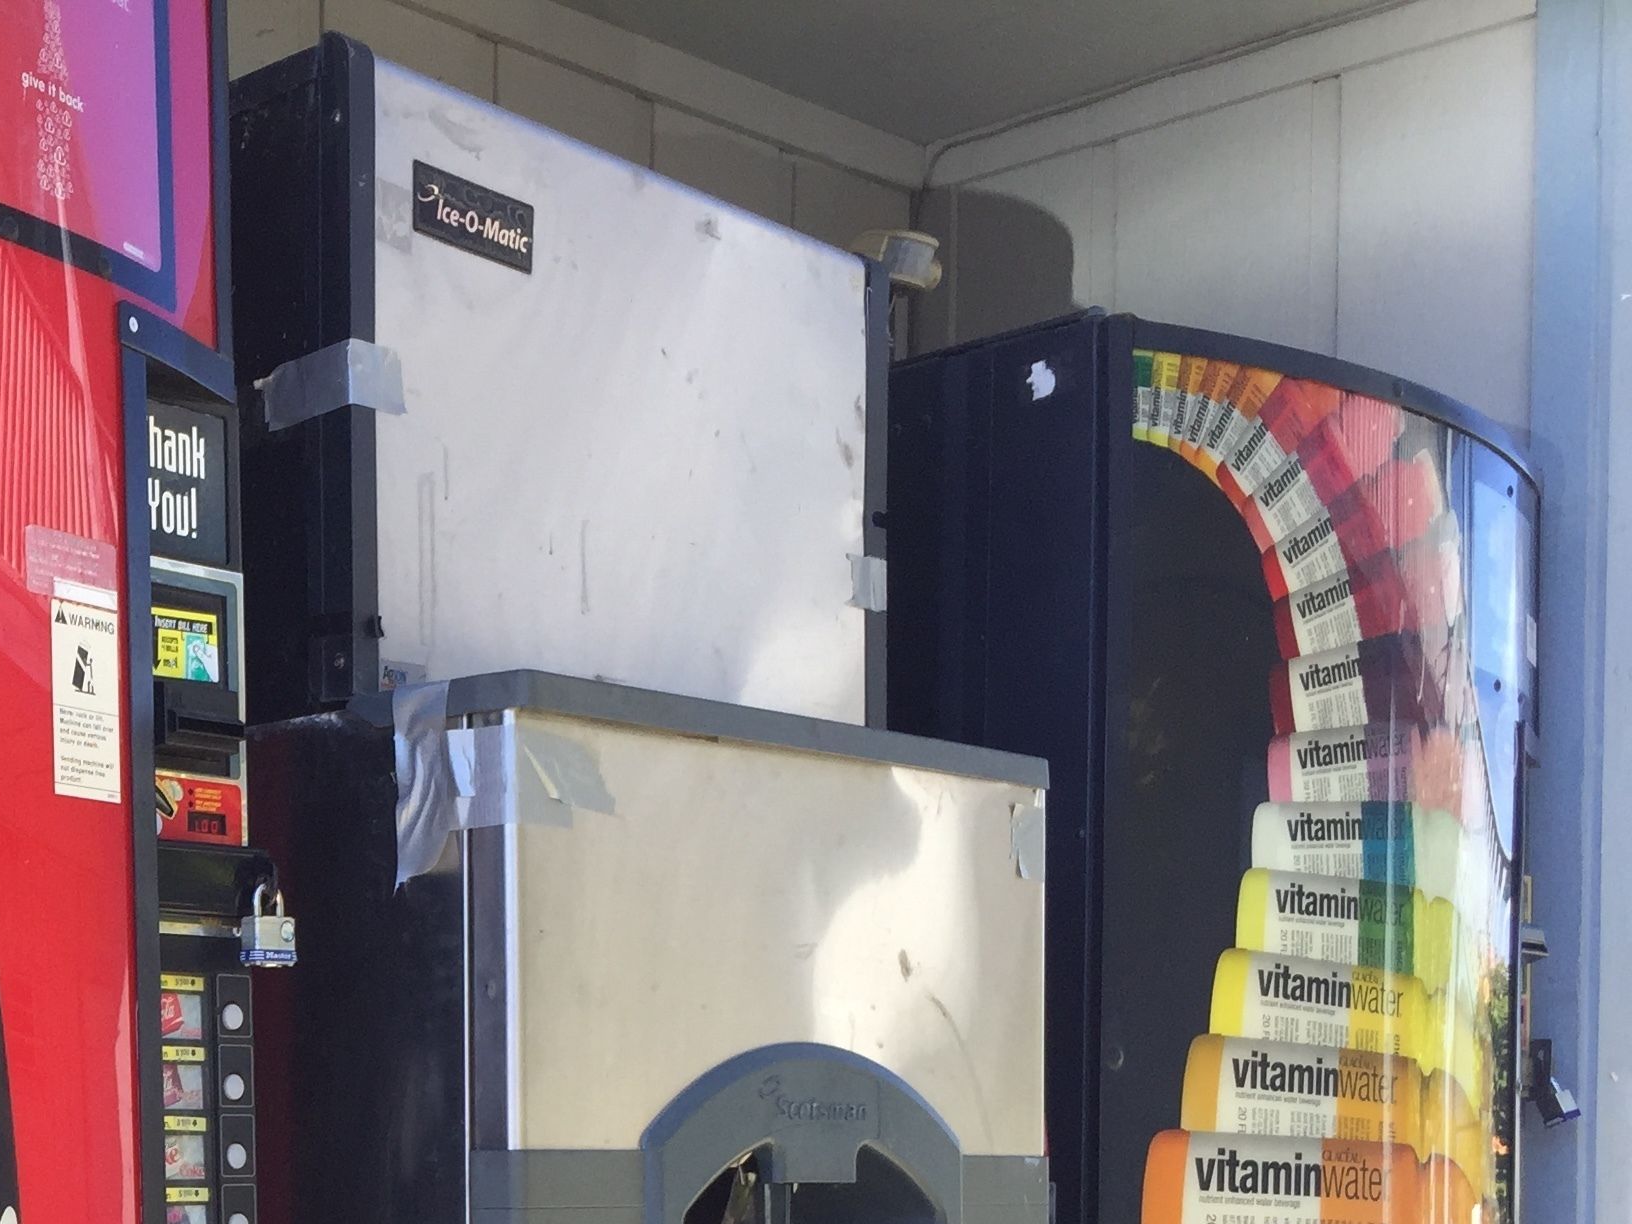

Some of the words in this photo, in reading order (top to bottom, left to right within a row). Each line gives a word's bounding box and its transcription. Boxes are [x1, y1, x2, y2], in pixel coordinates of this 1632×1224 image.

[22, 71, 45, 92] give
[48, 81, 57, 98] it
[59, 86, 84, 112] back
[436, 198, 529, 254] Ice-O-Matic
[1173, 390, 1188, 435] vitamin
[1188, 395, 1210, 443] vitamin
[1206, 400, 1236, 450] vitamin
[147, 415, 206, 480] hank
[1231, 422, 1269, 473] vitamin
[1260, 461, 1303, 508] vitamin
[1283, 515, 1335, 566] vitamin
[1296, 577, 1351, 619] vitamin
[68, 613, 115, 635] WARNING
[154, 615, 177, 629] INSERT
[192, 622, 208, 634] HERE
[1299, 654, 1363, 692] vitamin
